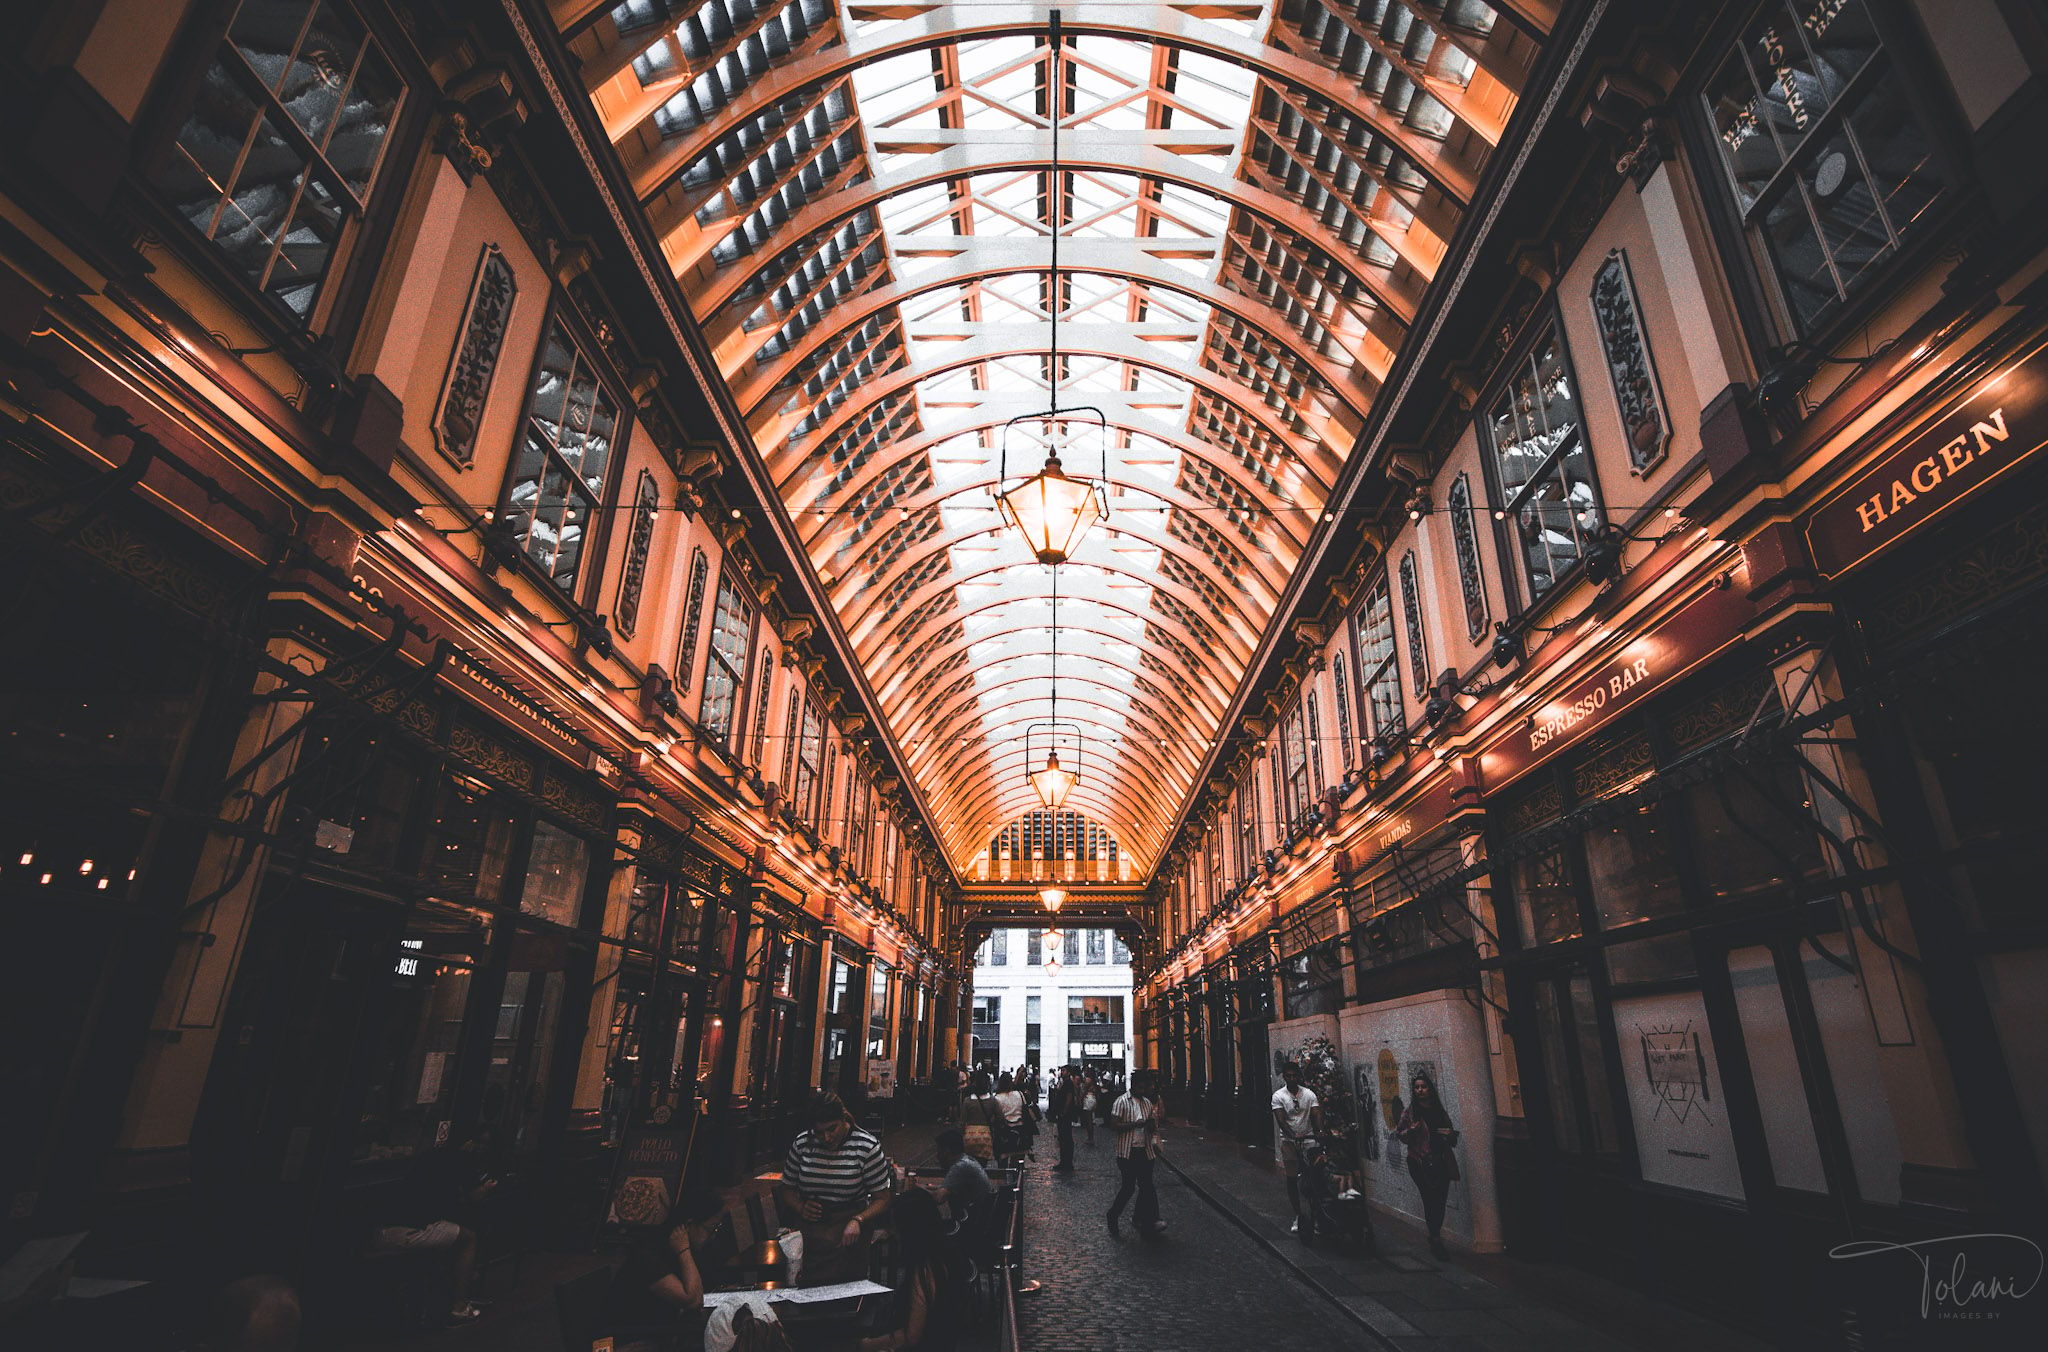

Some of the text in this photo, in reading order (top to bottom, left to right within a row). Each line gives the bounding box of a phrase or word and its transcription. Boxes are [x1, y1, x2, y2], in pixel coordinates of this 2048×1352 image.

[1855, 407, 2010, 533] HAGEN
[1529, 658, 1650, 751] ESPRESSO BAR
[1380, 819, 1411, 849] VIANDAS
